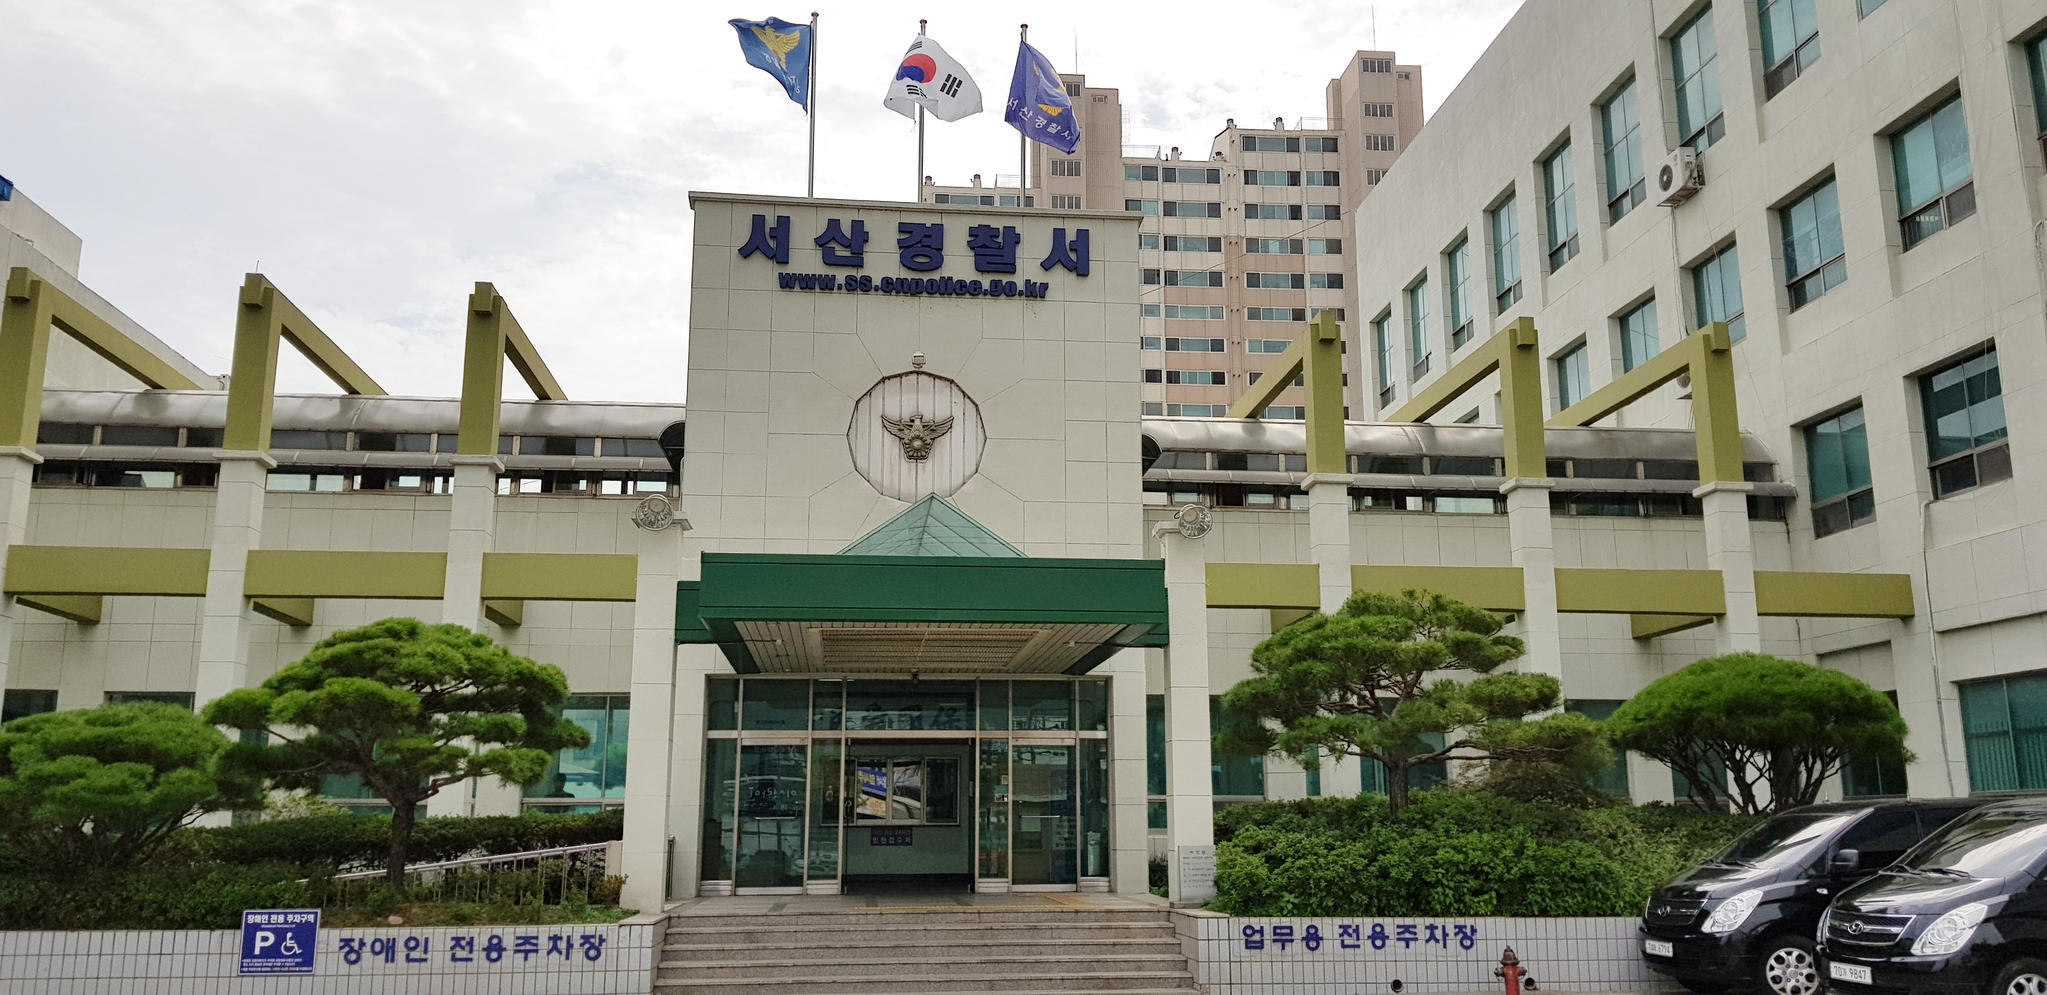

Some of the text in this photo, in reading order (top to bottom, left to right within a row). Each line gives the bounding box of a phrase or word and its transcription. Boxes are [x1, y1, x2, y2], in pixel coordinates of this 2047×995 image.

[738, 214, 1090, 276] 서산경찰서
[778, 272, 1048, 299] www.ss.cnpolice.go.kr
[247, 914, 269, 924] 장애인
[270, 914, 285, 923] 전용
[254, 931, 275, 955] P
[338, 933, 607, 965] 장애인 전용주차장
[1242, 923, 1477, 951] 업무용 전용주차장
